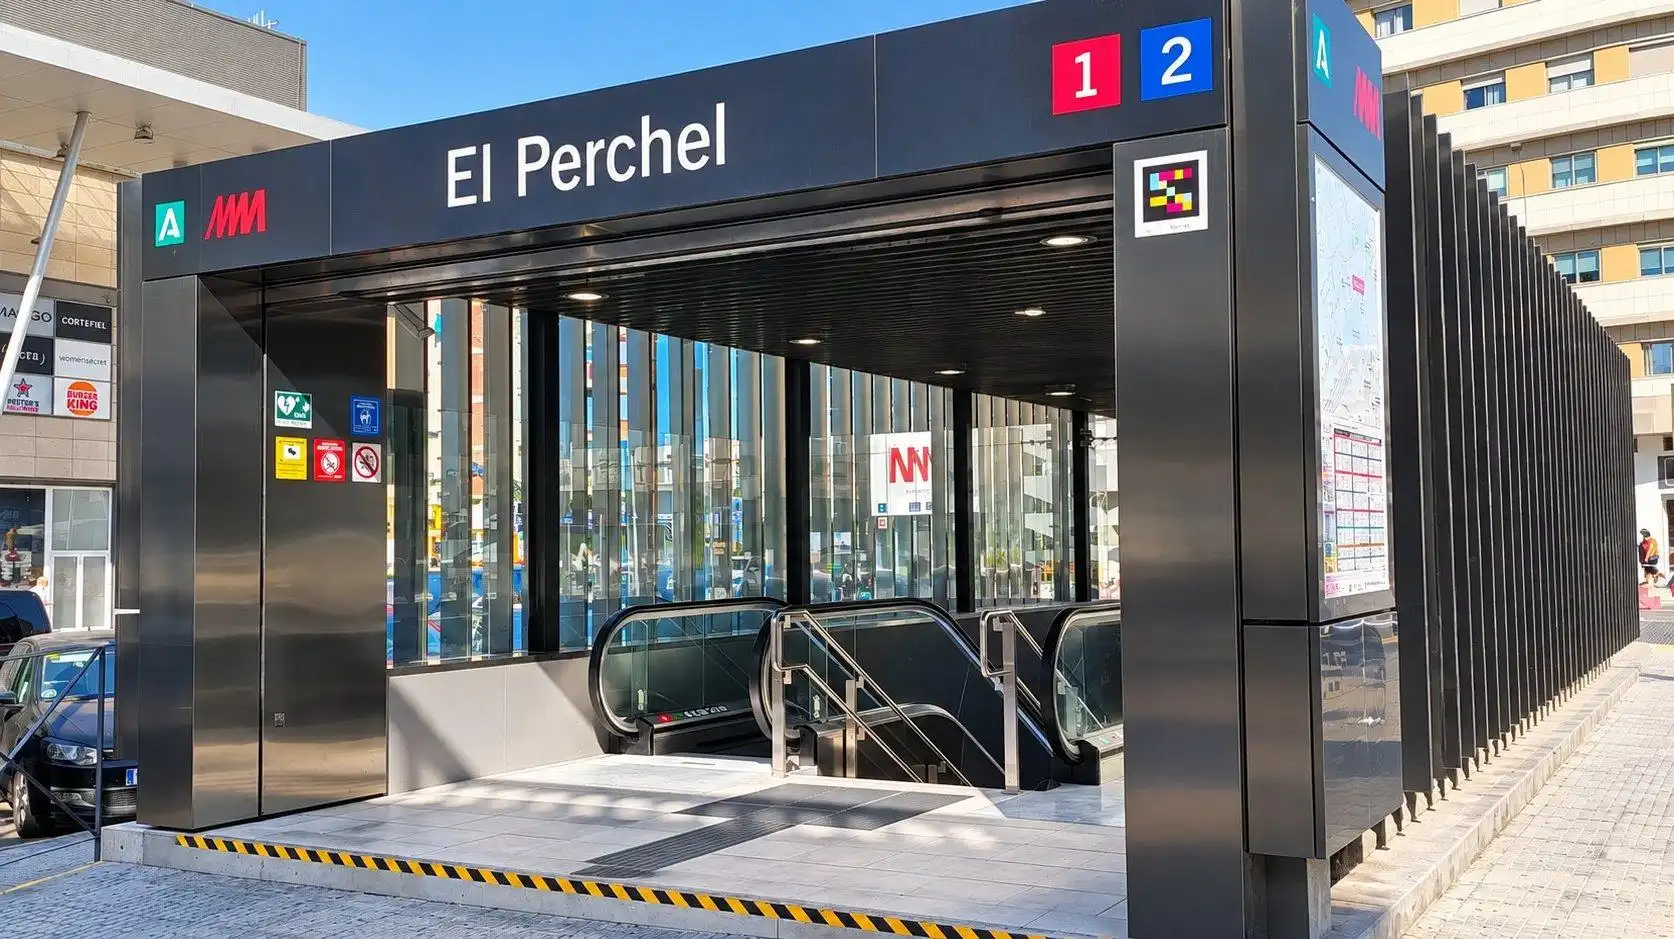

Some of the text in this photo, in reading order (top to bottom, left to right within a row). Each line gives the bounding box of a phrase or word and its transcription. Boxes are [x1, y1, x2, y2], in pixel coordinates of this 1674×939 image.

[1161, 36, 1192, 86] 2
[1315, 29, 1330, 81] A
[1074, 51, 1098, 99] 1
[447, 101, 726, 208] El Perchel
[156, 205, 178, 236] A
[0, 306, 53, 323] MAGO
[61, 316, 107, 330] CORTEFIEL
[58, 354, 108, 366] womensecret
[67, 390, 98, 401] BURGER
[67, 398, 98, 411] KING
